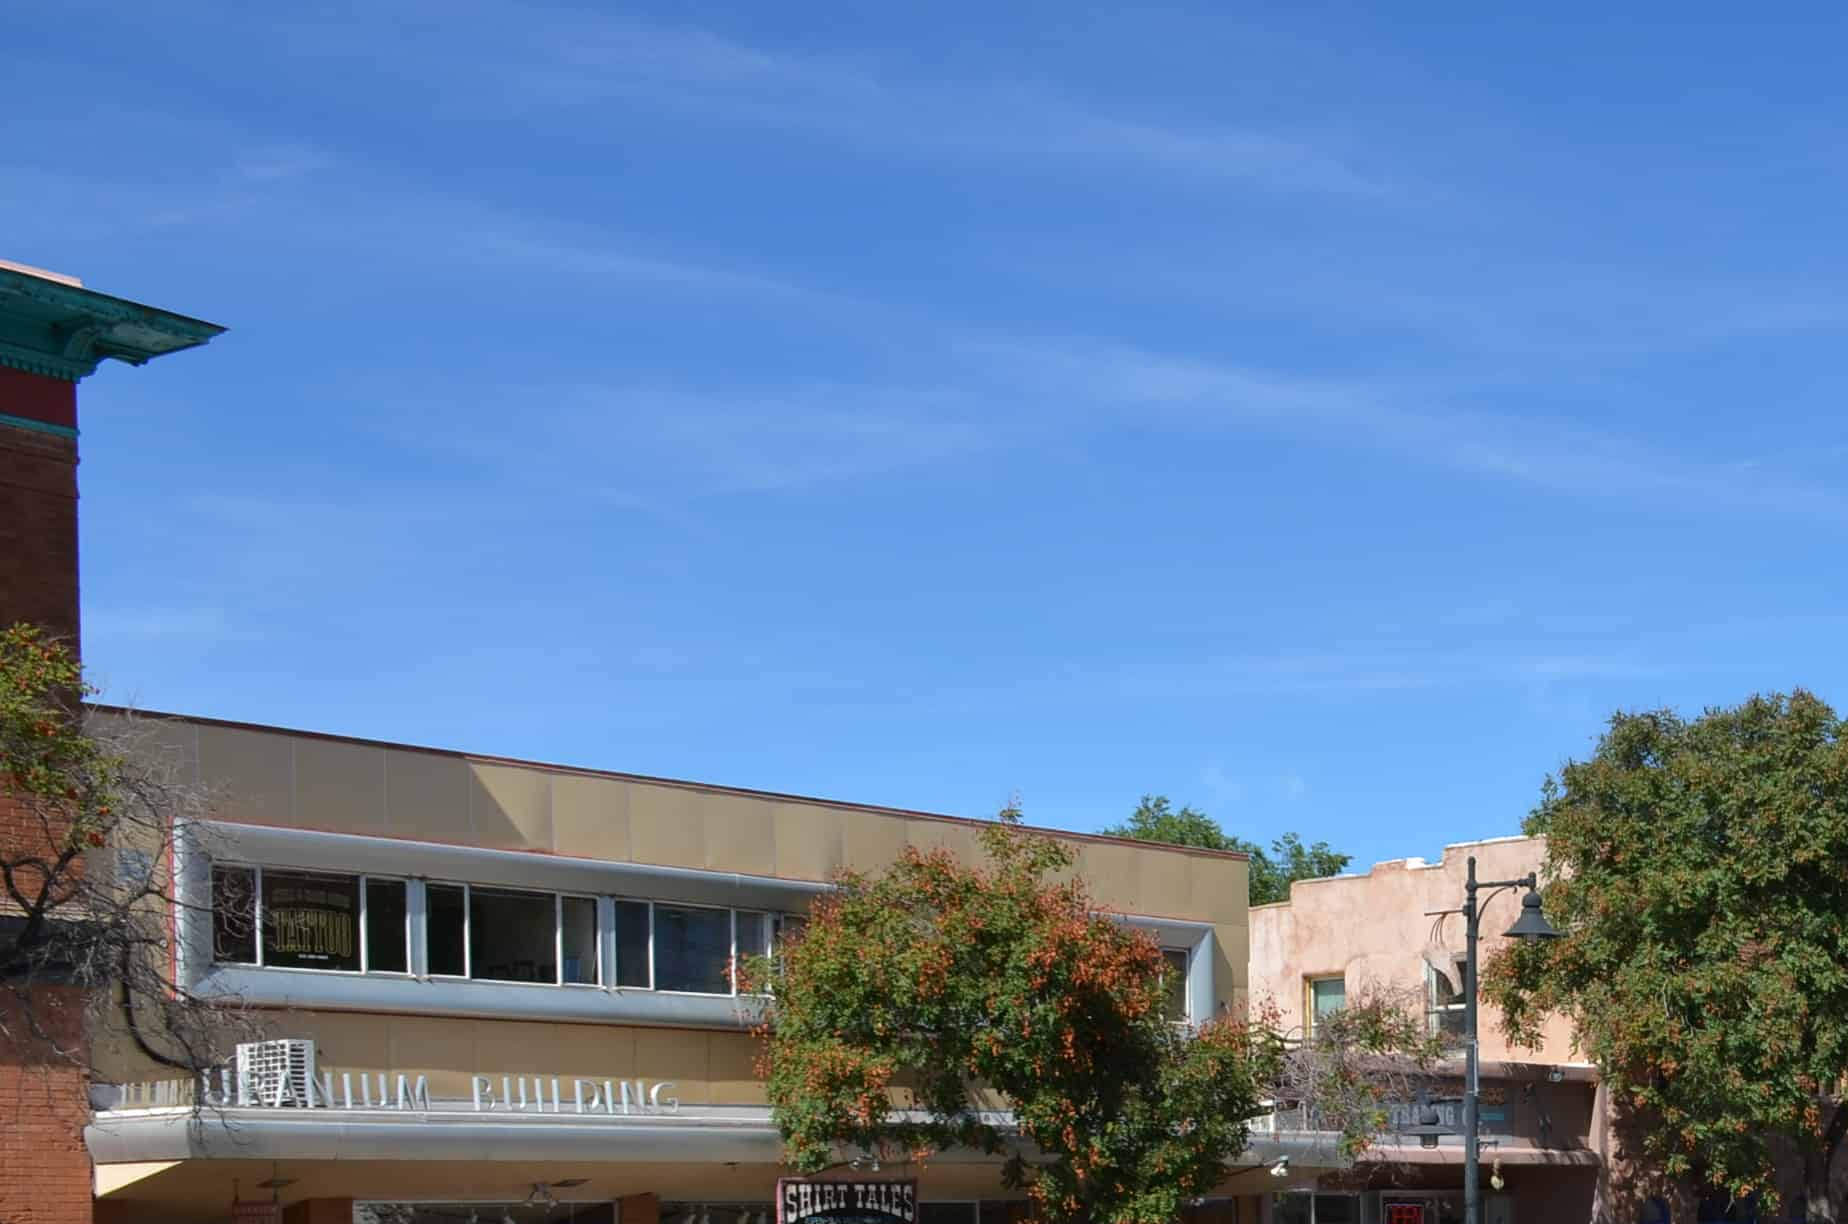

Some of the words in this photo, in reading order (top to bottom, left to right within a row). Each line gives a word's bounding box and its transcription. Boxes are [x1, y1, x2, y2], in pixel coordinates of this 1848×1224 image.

[201, 1067, 431, 1111] URANIUM
[471, 1075, 680, 1115] BUILDING
[785, 1183, 848, 1224] SHIRT
[854, 1183, 914, 1223] TALES
